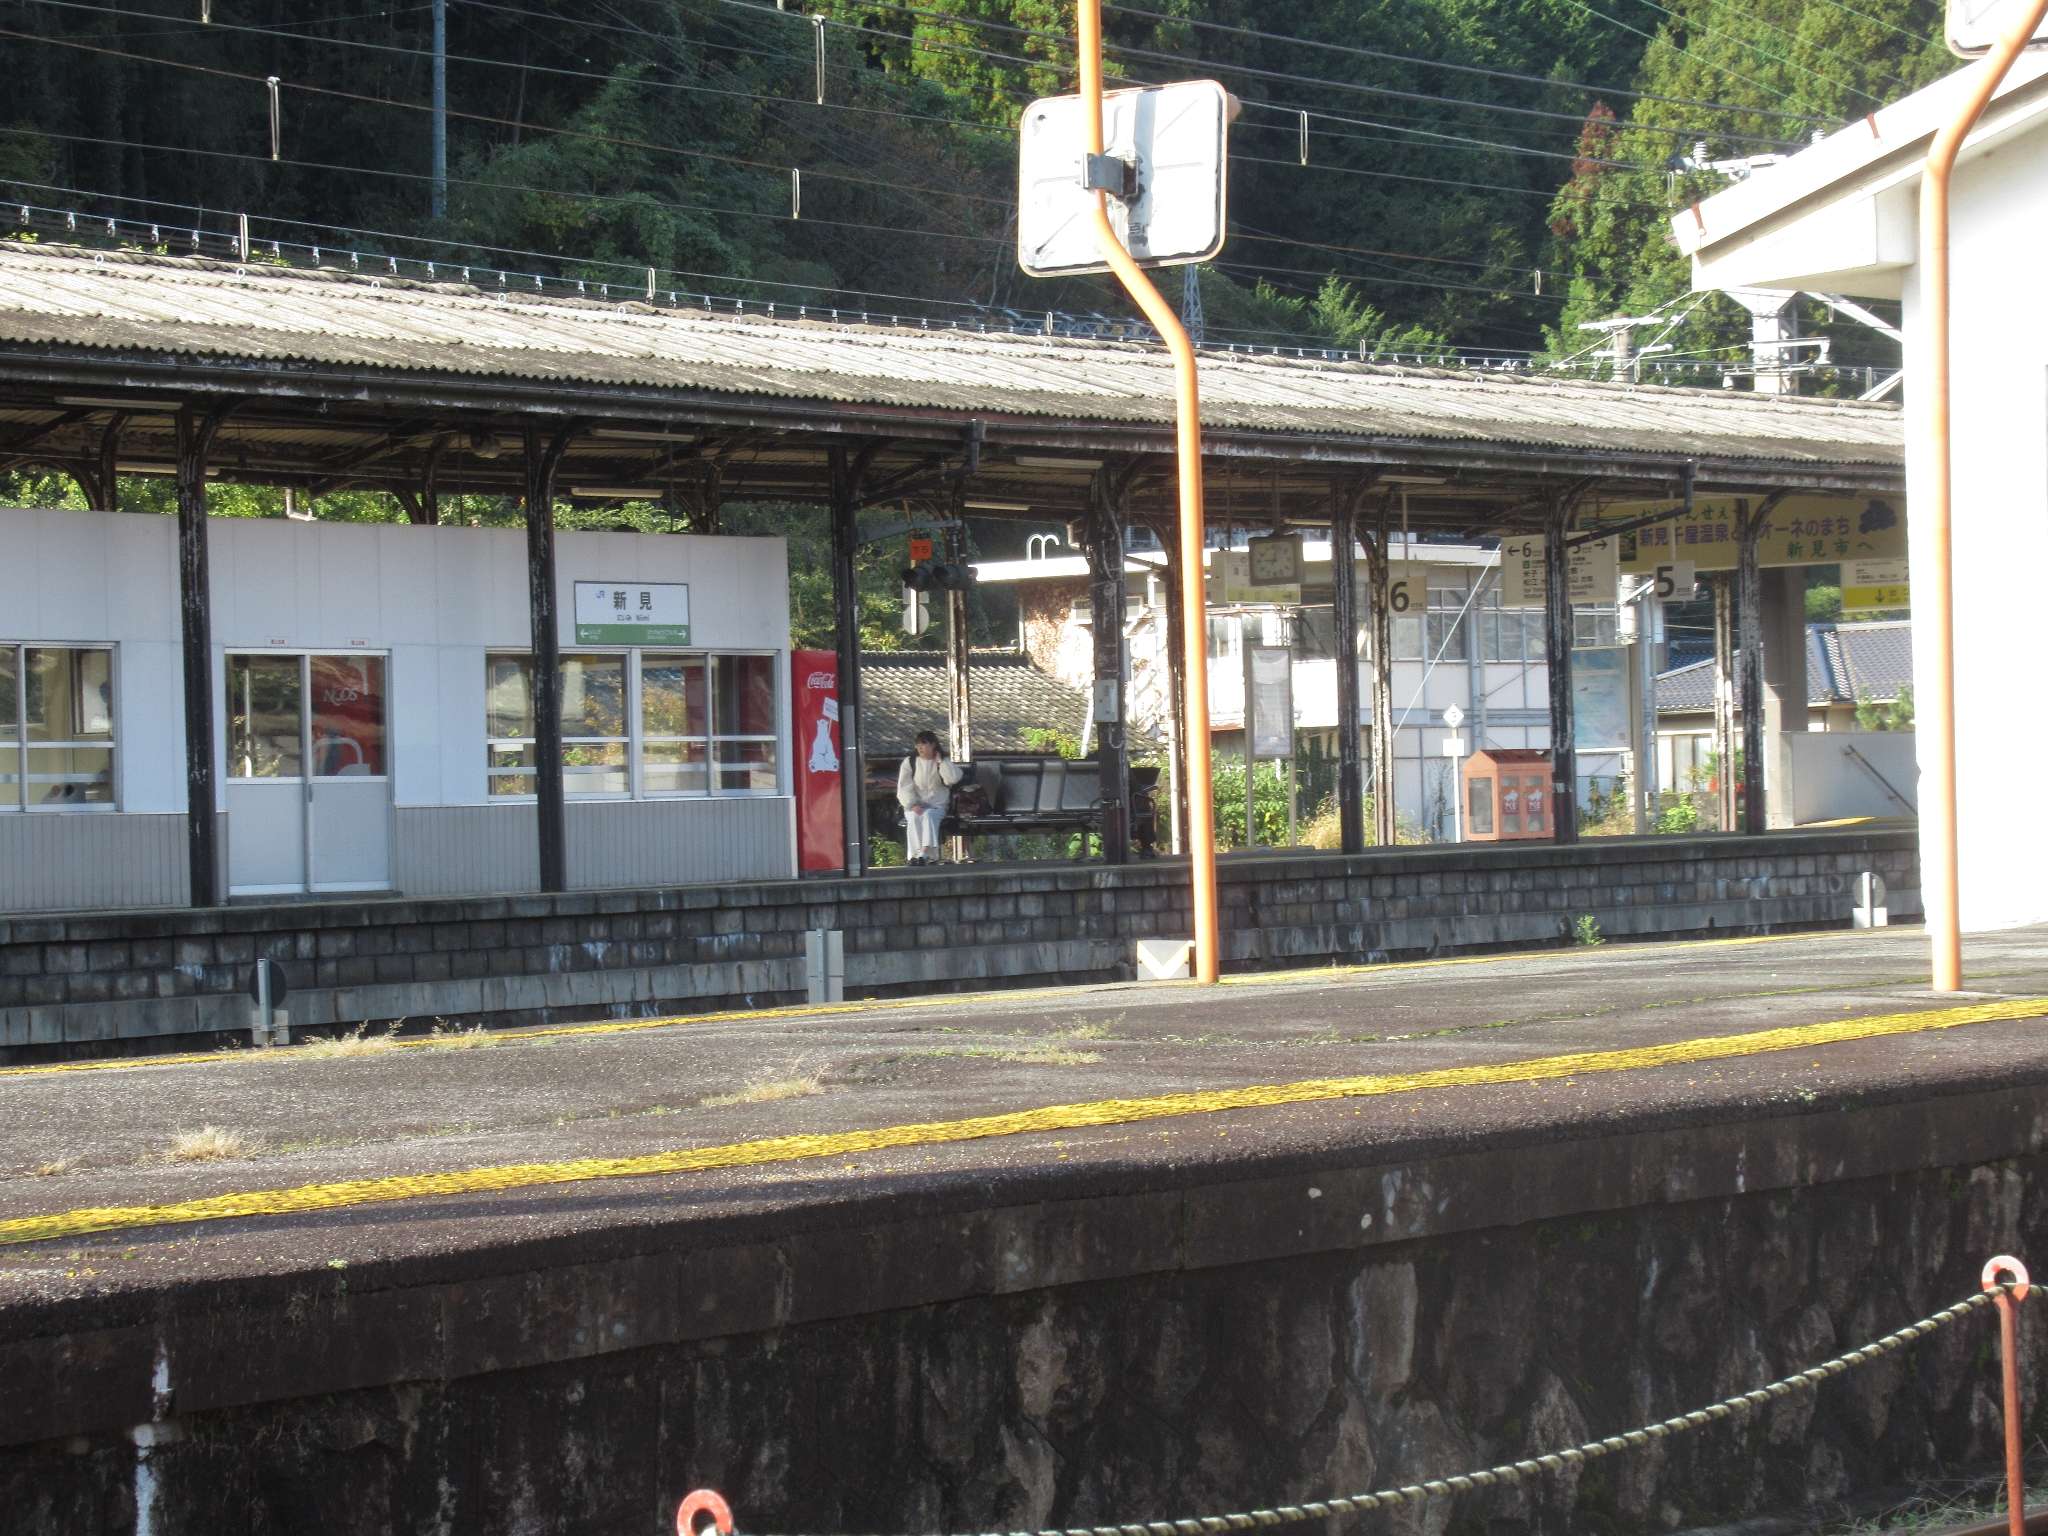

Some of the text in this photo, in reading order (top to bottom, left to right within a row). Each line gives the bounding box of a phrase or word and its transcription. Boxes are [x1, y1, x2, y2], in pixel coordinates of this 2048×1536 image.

[1522, 542, 1532, 558] 6
[1657, 566, 1674, 598] 5
[613, 591, 652, 611] 新見
[1391, 581, 1409, 612] 6
